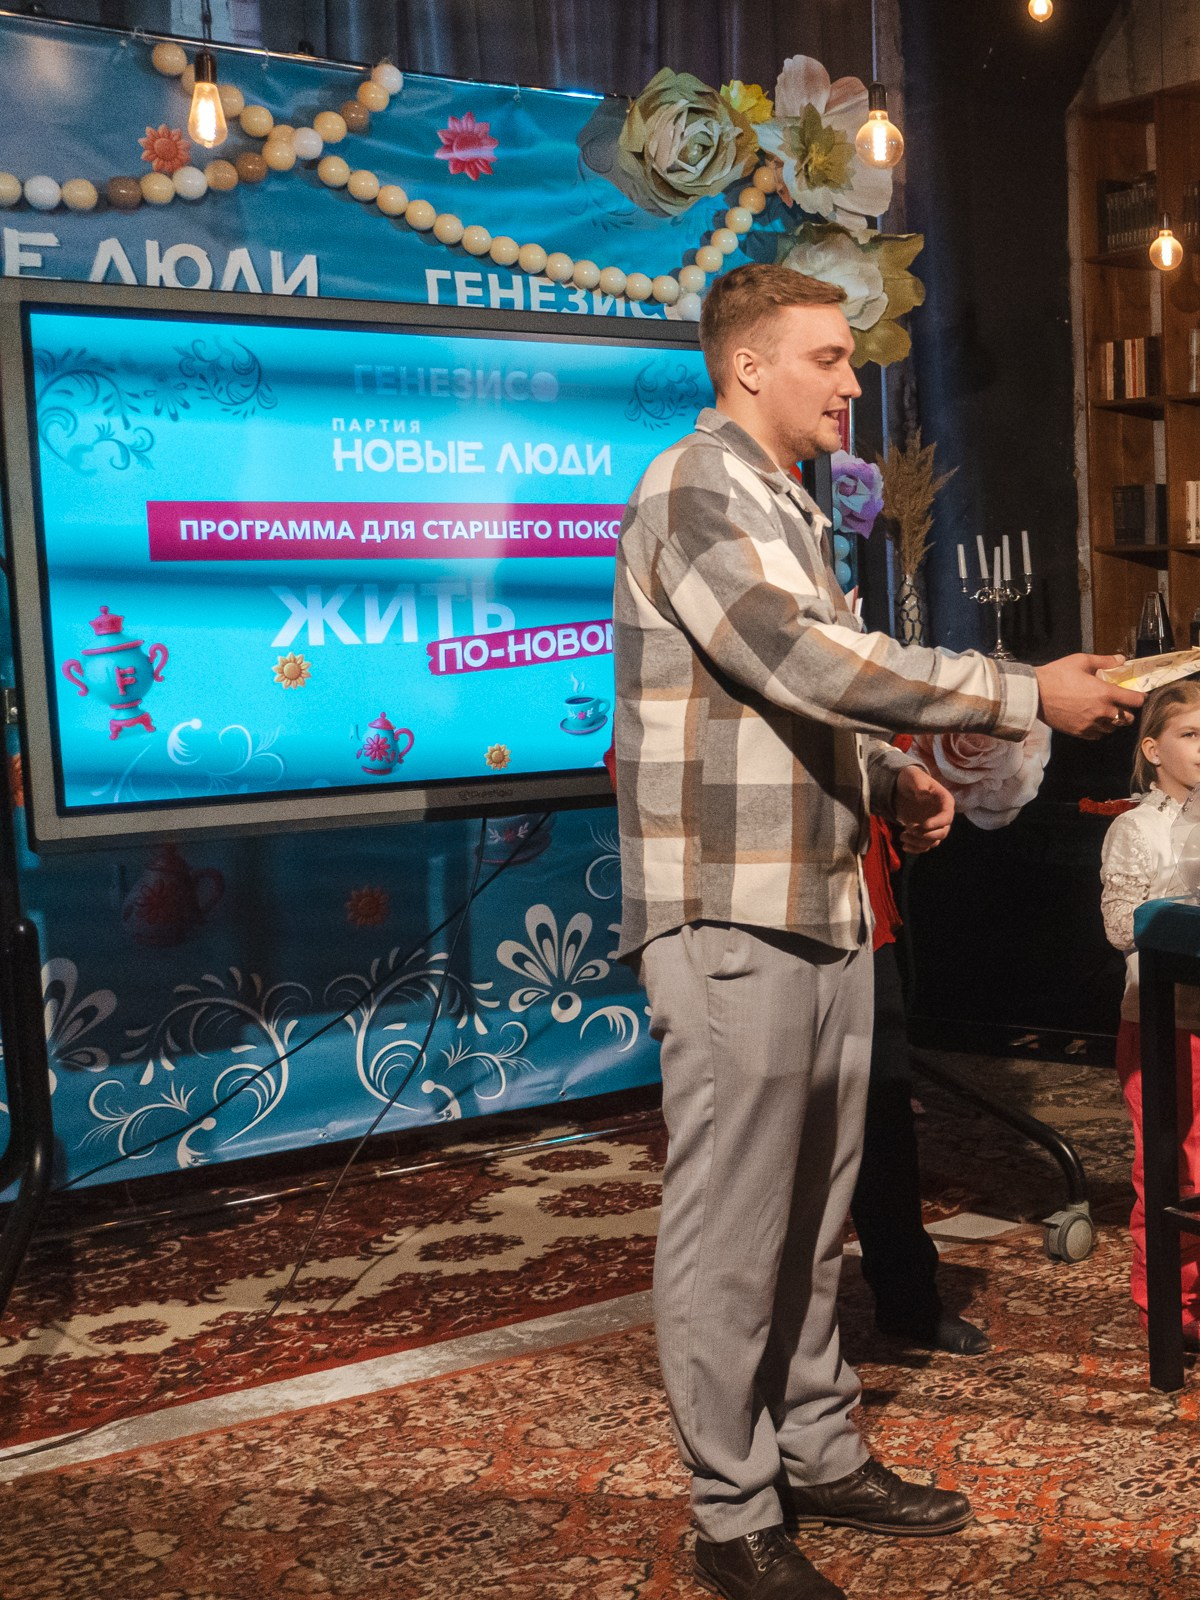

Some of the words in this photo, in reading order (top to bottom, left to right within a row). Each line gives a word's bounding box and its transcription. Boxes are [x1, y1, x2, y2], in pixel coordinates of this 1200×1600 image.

[354, 364, 531, 402] ГЕНЕЗИС
[332, 417, 422, 434] ПАРТИЯ
[333, 438, 486, 474] НОВЫЕ
[495, 442, 612, 476] ЛЮДИ
[180, 519, 356, 541] ПРОГРАММА
[360, 519, 416, 544] ДЛЯ
[422, 519, 553, 540] СТАРШЕГО
[270, 582, 517, 648] ЖИТЬ
